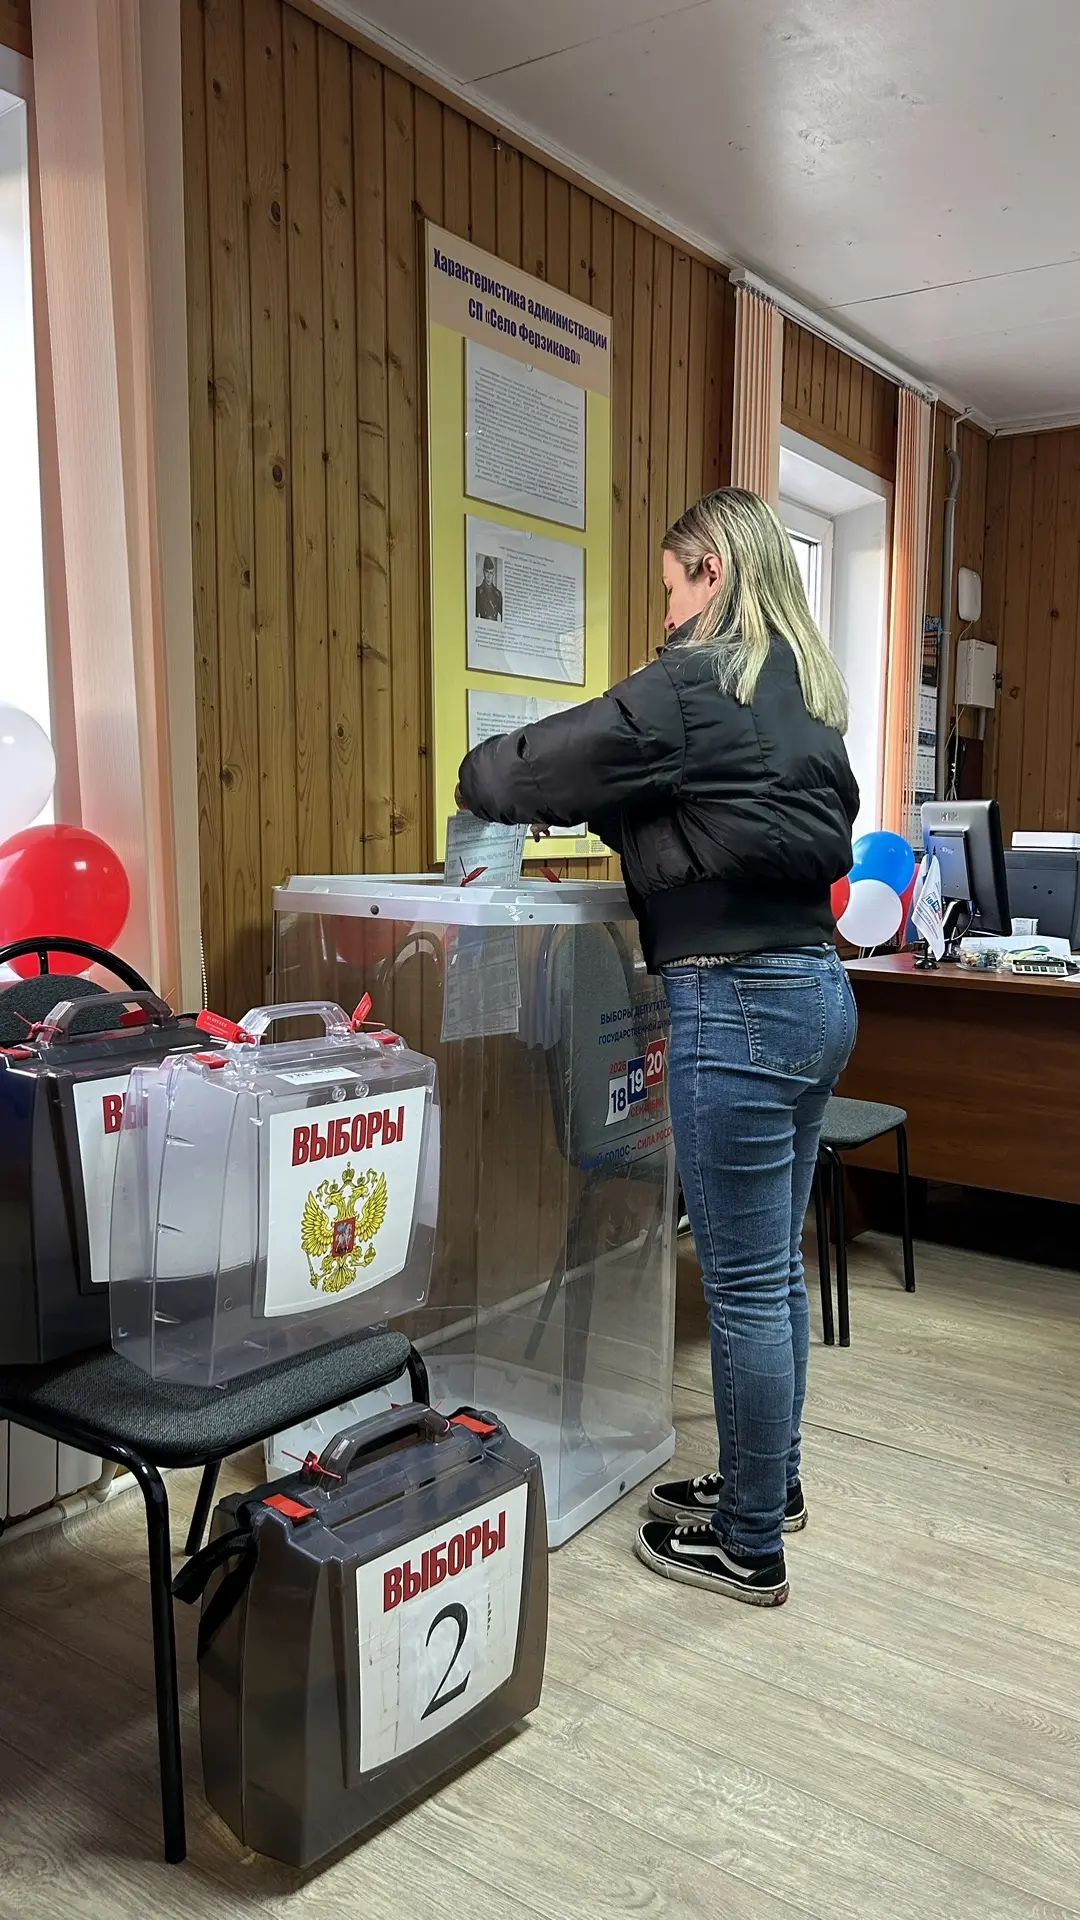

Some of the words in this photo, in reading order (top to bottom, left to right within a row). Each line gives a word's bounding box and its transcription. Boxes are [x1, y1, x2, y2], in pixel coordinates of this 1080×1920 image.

[433, 247, 526, 311] Характеристика
[527, 298, 608, 350] администрации
[468, 298, 483, 321] СП
[485, 308, 517, 337] «Село
[519, 323, 581, 365] Ферзиково»
[600, 1007, 634, 1025] ВЫБОРЫ
[629, 1068, 644, 1094] 19
[646, 1050, 663, 1077] 20
[611, 1087, 627, 1114] 18
[291, 1106, 405, 1167] ВЫБОРЫ
[605, 1144, 630, 1160] ГОЛОС
[637, 1136, 655, 1150] СИЛА
[383, 1510, 506, 1613] ВЫБОРЫ
[420, 1601, 471, 1721] 2
